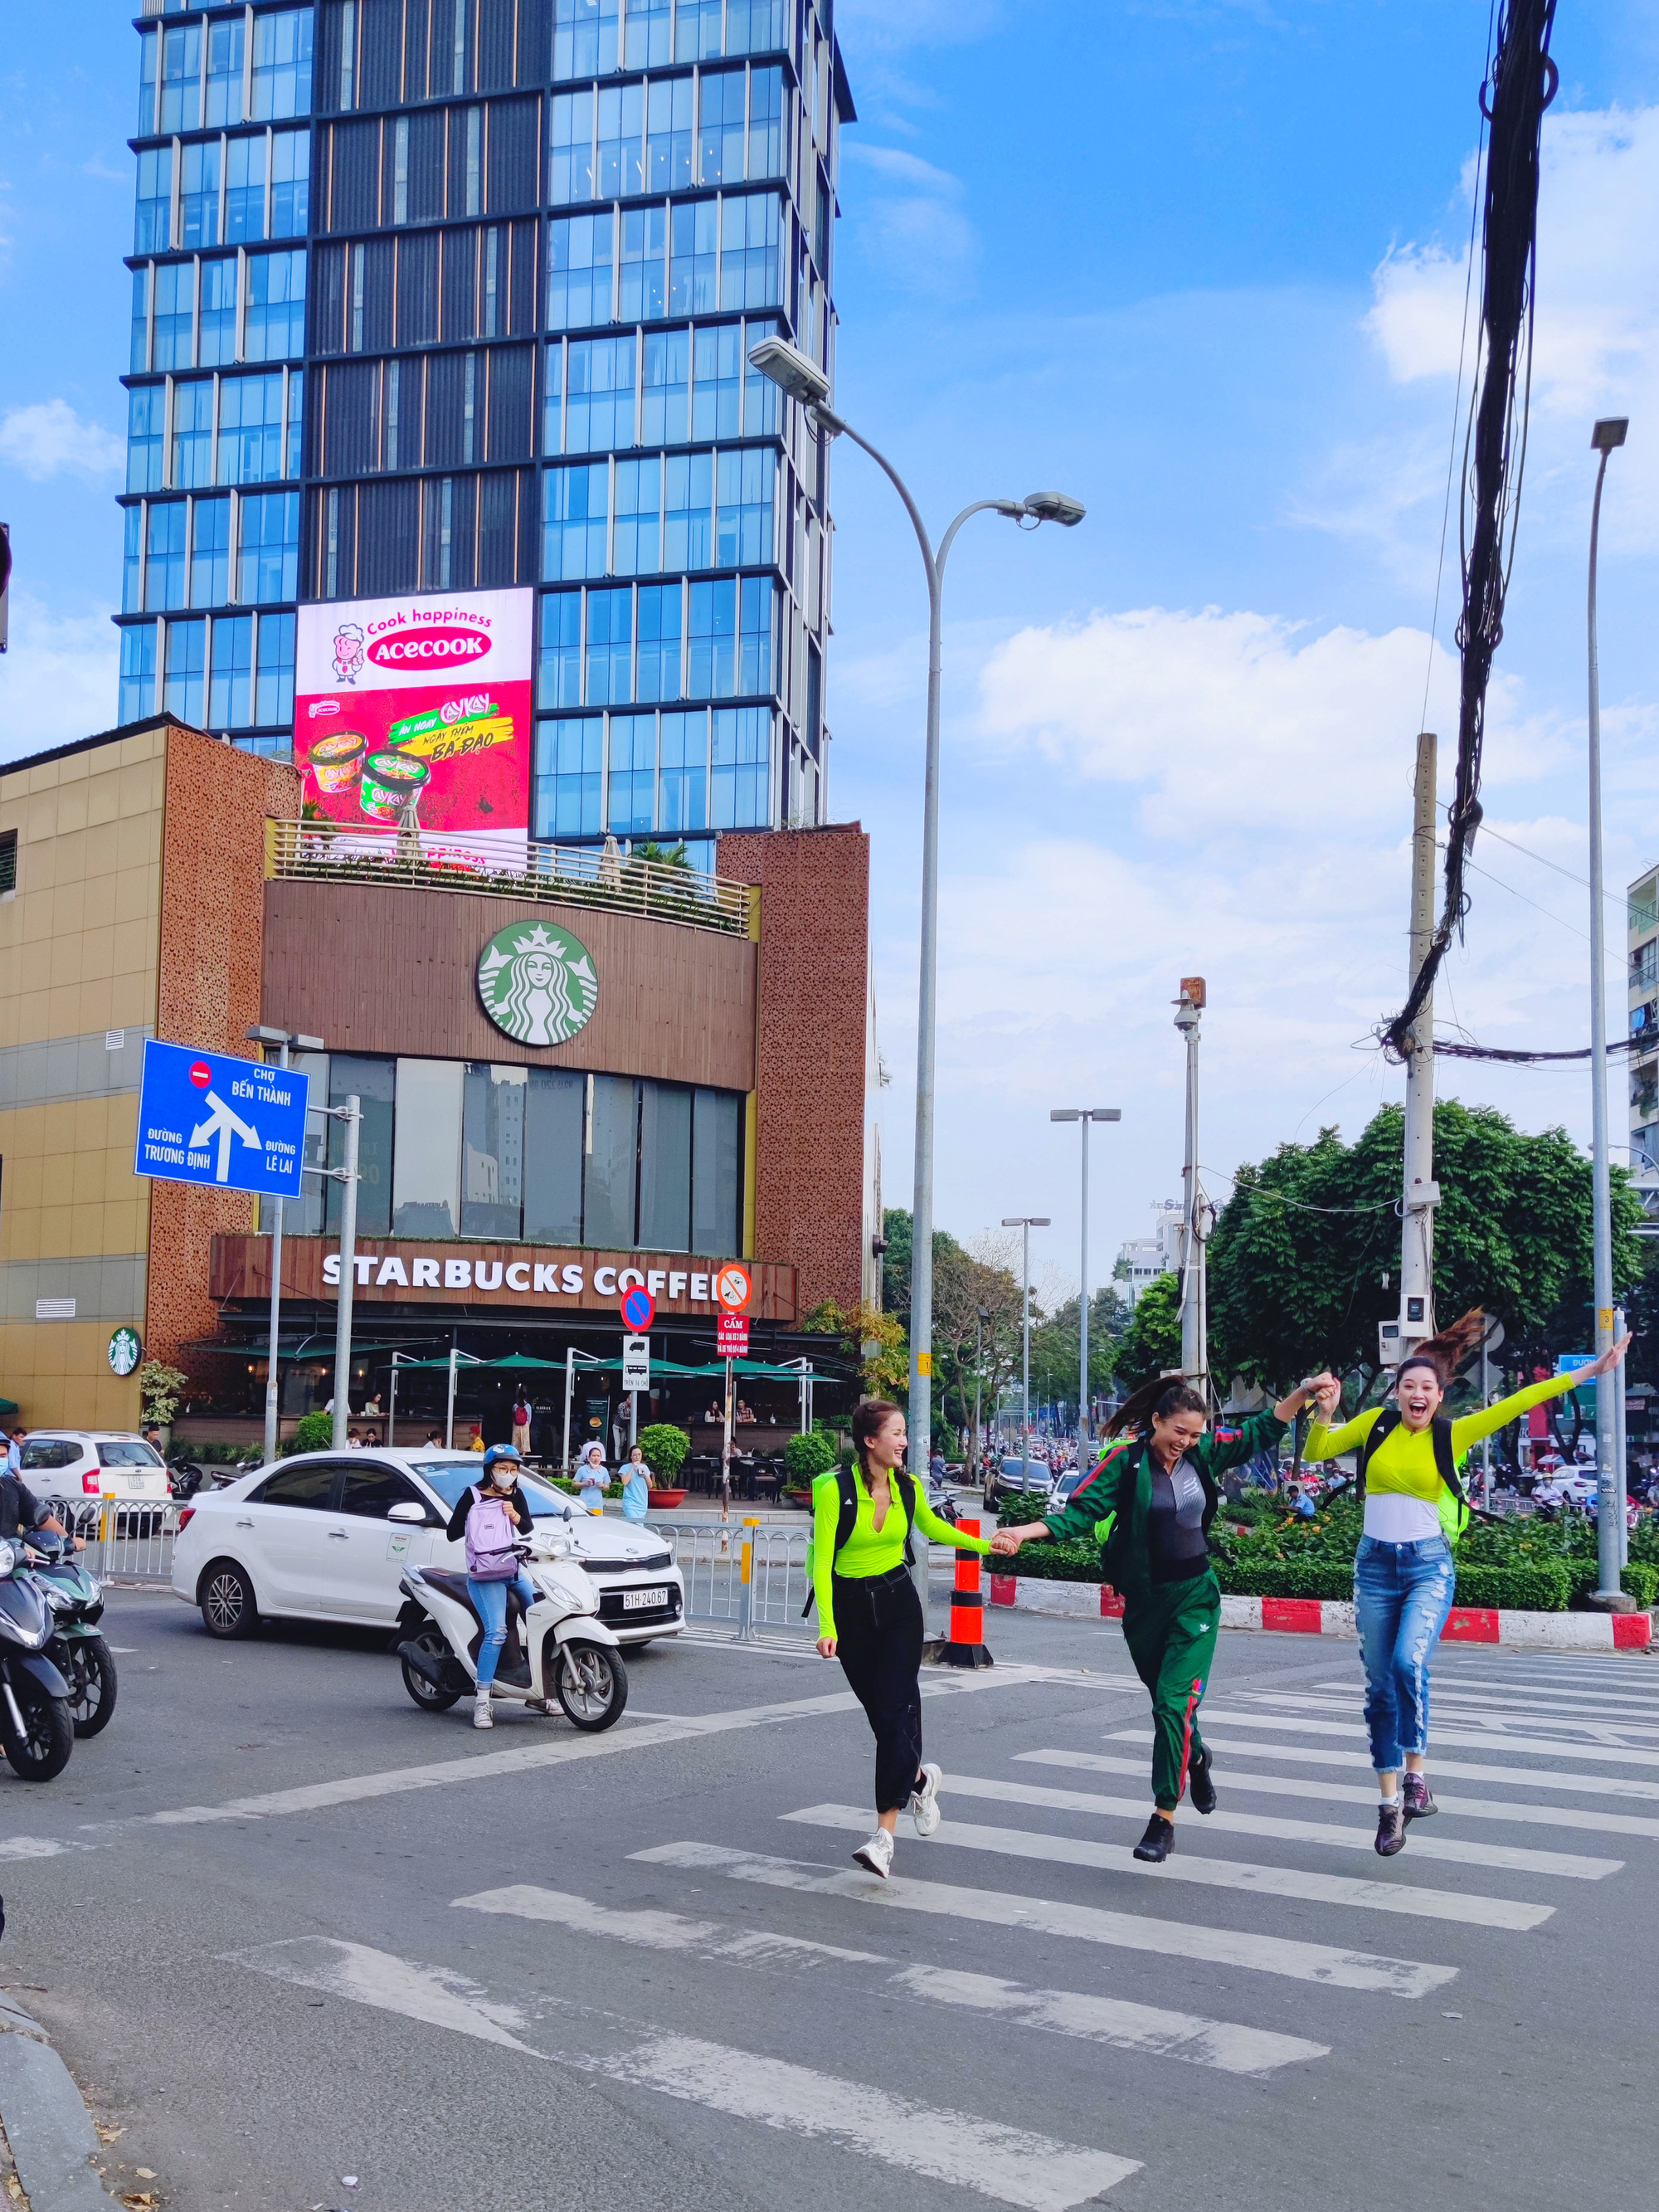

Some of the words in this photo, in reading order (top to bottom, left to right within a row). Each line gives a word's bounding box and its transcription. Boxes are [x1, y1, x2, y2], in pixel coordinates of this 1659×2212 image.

[367, 611, 407, 635] Cook
[412, 607, 493, 628] happiness
[413, 718, 437, 732] NGAY
[254, 1068, 275, 1084] CHỢ
[232, 1079, 254, 1099] BẾN
[258, 1084, 291, 1106] THÀNH
[148, 1128, 182, 1144] ĐƯỜNG
[265, 1139, 295, 1155] ĐƯỜNG
[145, 1144, 185, 1165] TRƯƠNG
[187, 1150, 211, 1170] ĐỊNH
[265, 1155, 277, 1172] LÊ
[280, 1157, 293, 1174] LAI
[323, 1254, 584, 1294] STARBUCKS
[724, 1316, 743, 1329] CẤM
